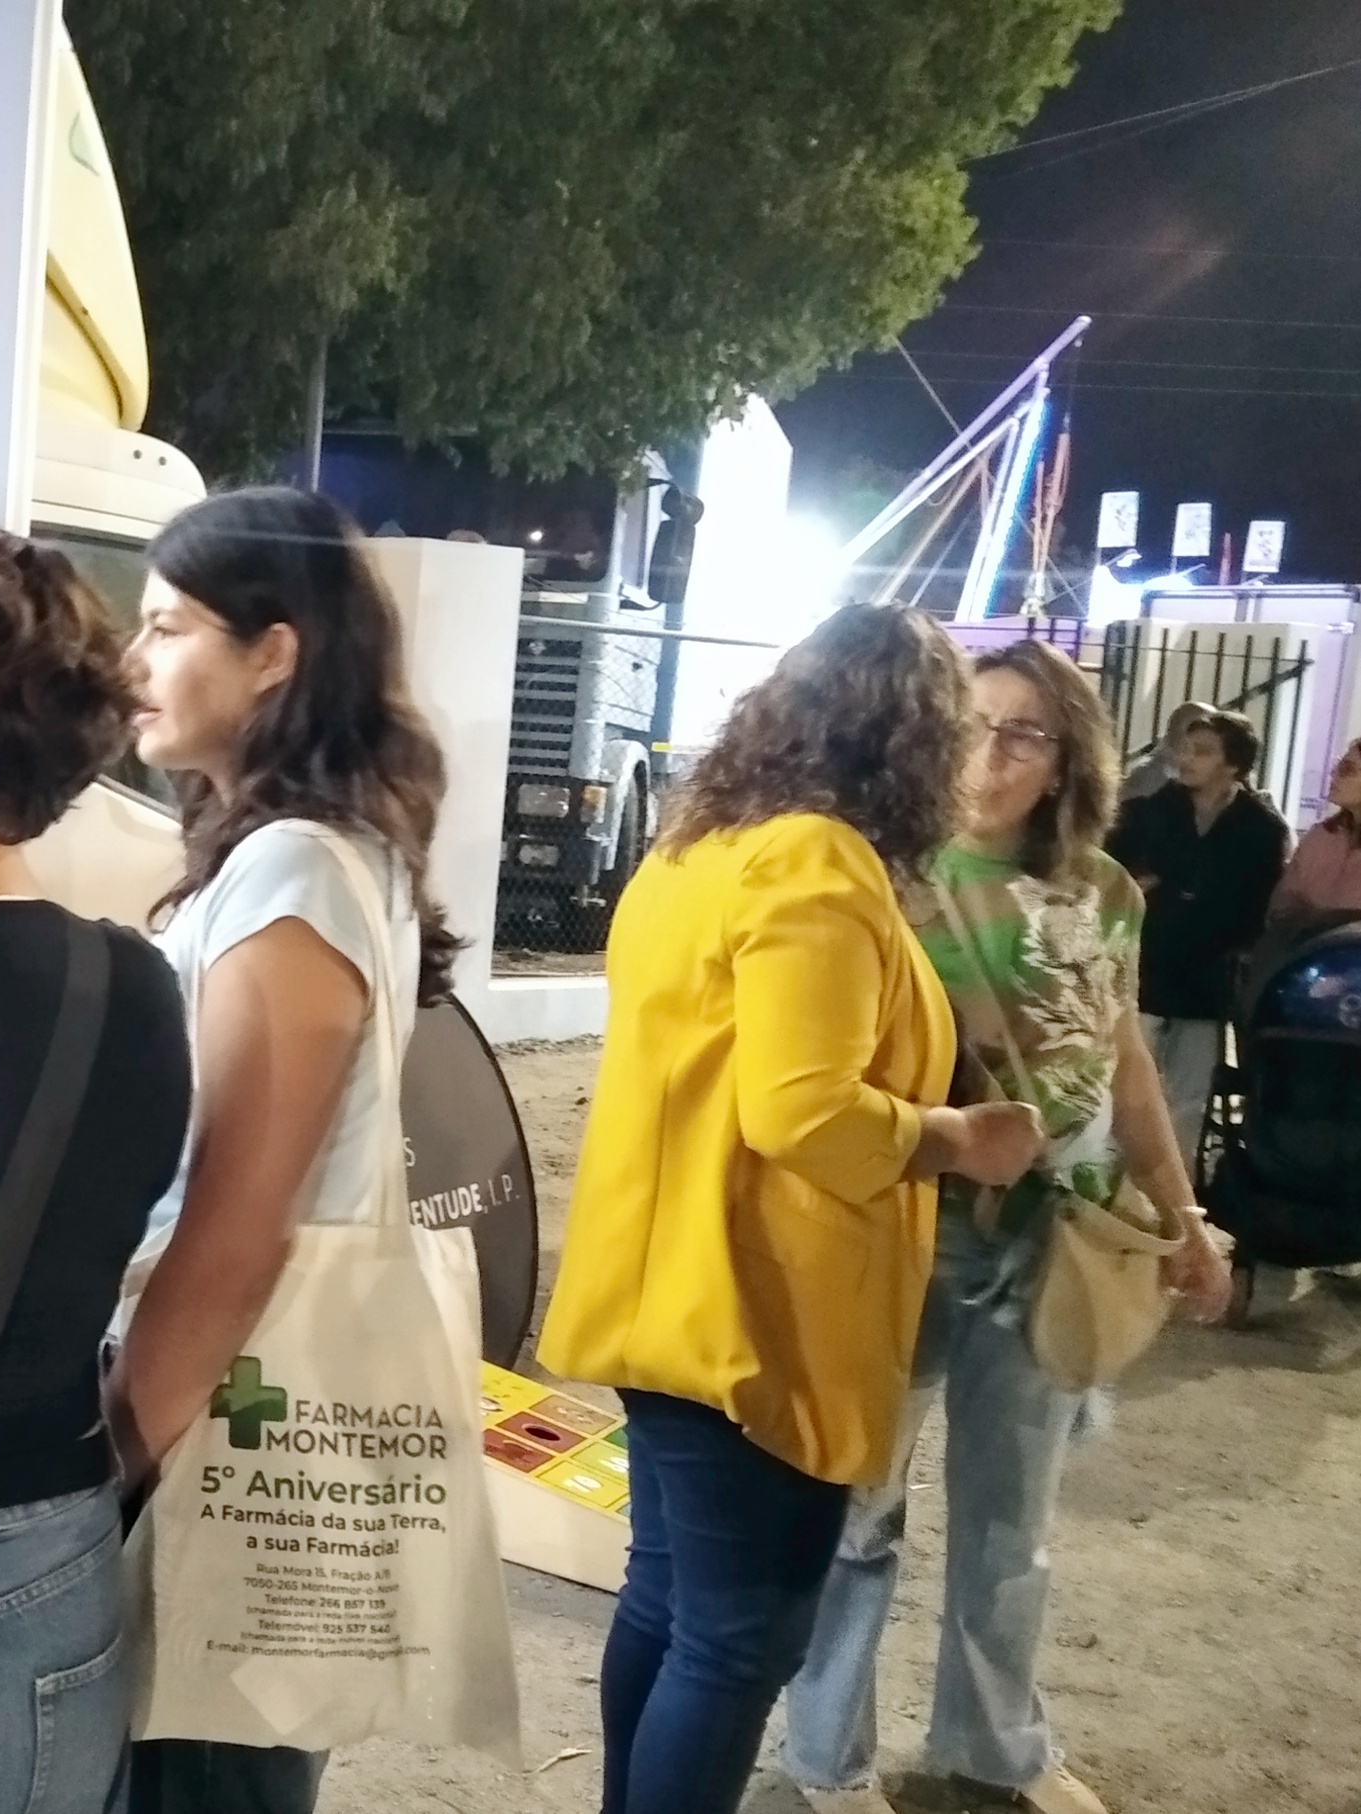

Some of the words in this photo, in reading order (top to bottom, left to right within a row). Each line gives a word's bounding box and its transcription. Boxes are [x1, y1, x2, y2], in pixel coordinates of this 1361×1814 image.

[294, 1399, 444, 1429] FARMACIA
[266, 1427, 447, 1460] MONTEMOR
[246, 1470, 447, 1506] Aniversário
[200, 1504, 215, 1520] A
[222, 1505, 316, 1528] Farmácia
[322, 1512, 347, 1531] da
[353, 1517, 386, 1532] sua
[391, 1514, 447, 1533] Terra,
[246, 1535, 258, 1549] a
[264, 1537, 301, 1553] sua
[307, 1537, 400, 1557] Farmácia!
[256, 1563, 280, 1575] Rua
[283, 1566, 312, 1578] Mora
